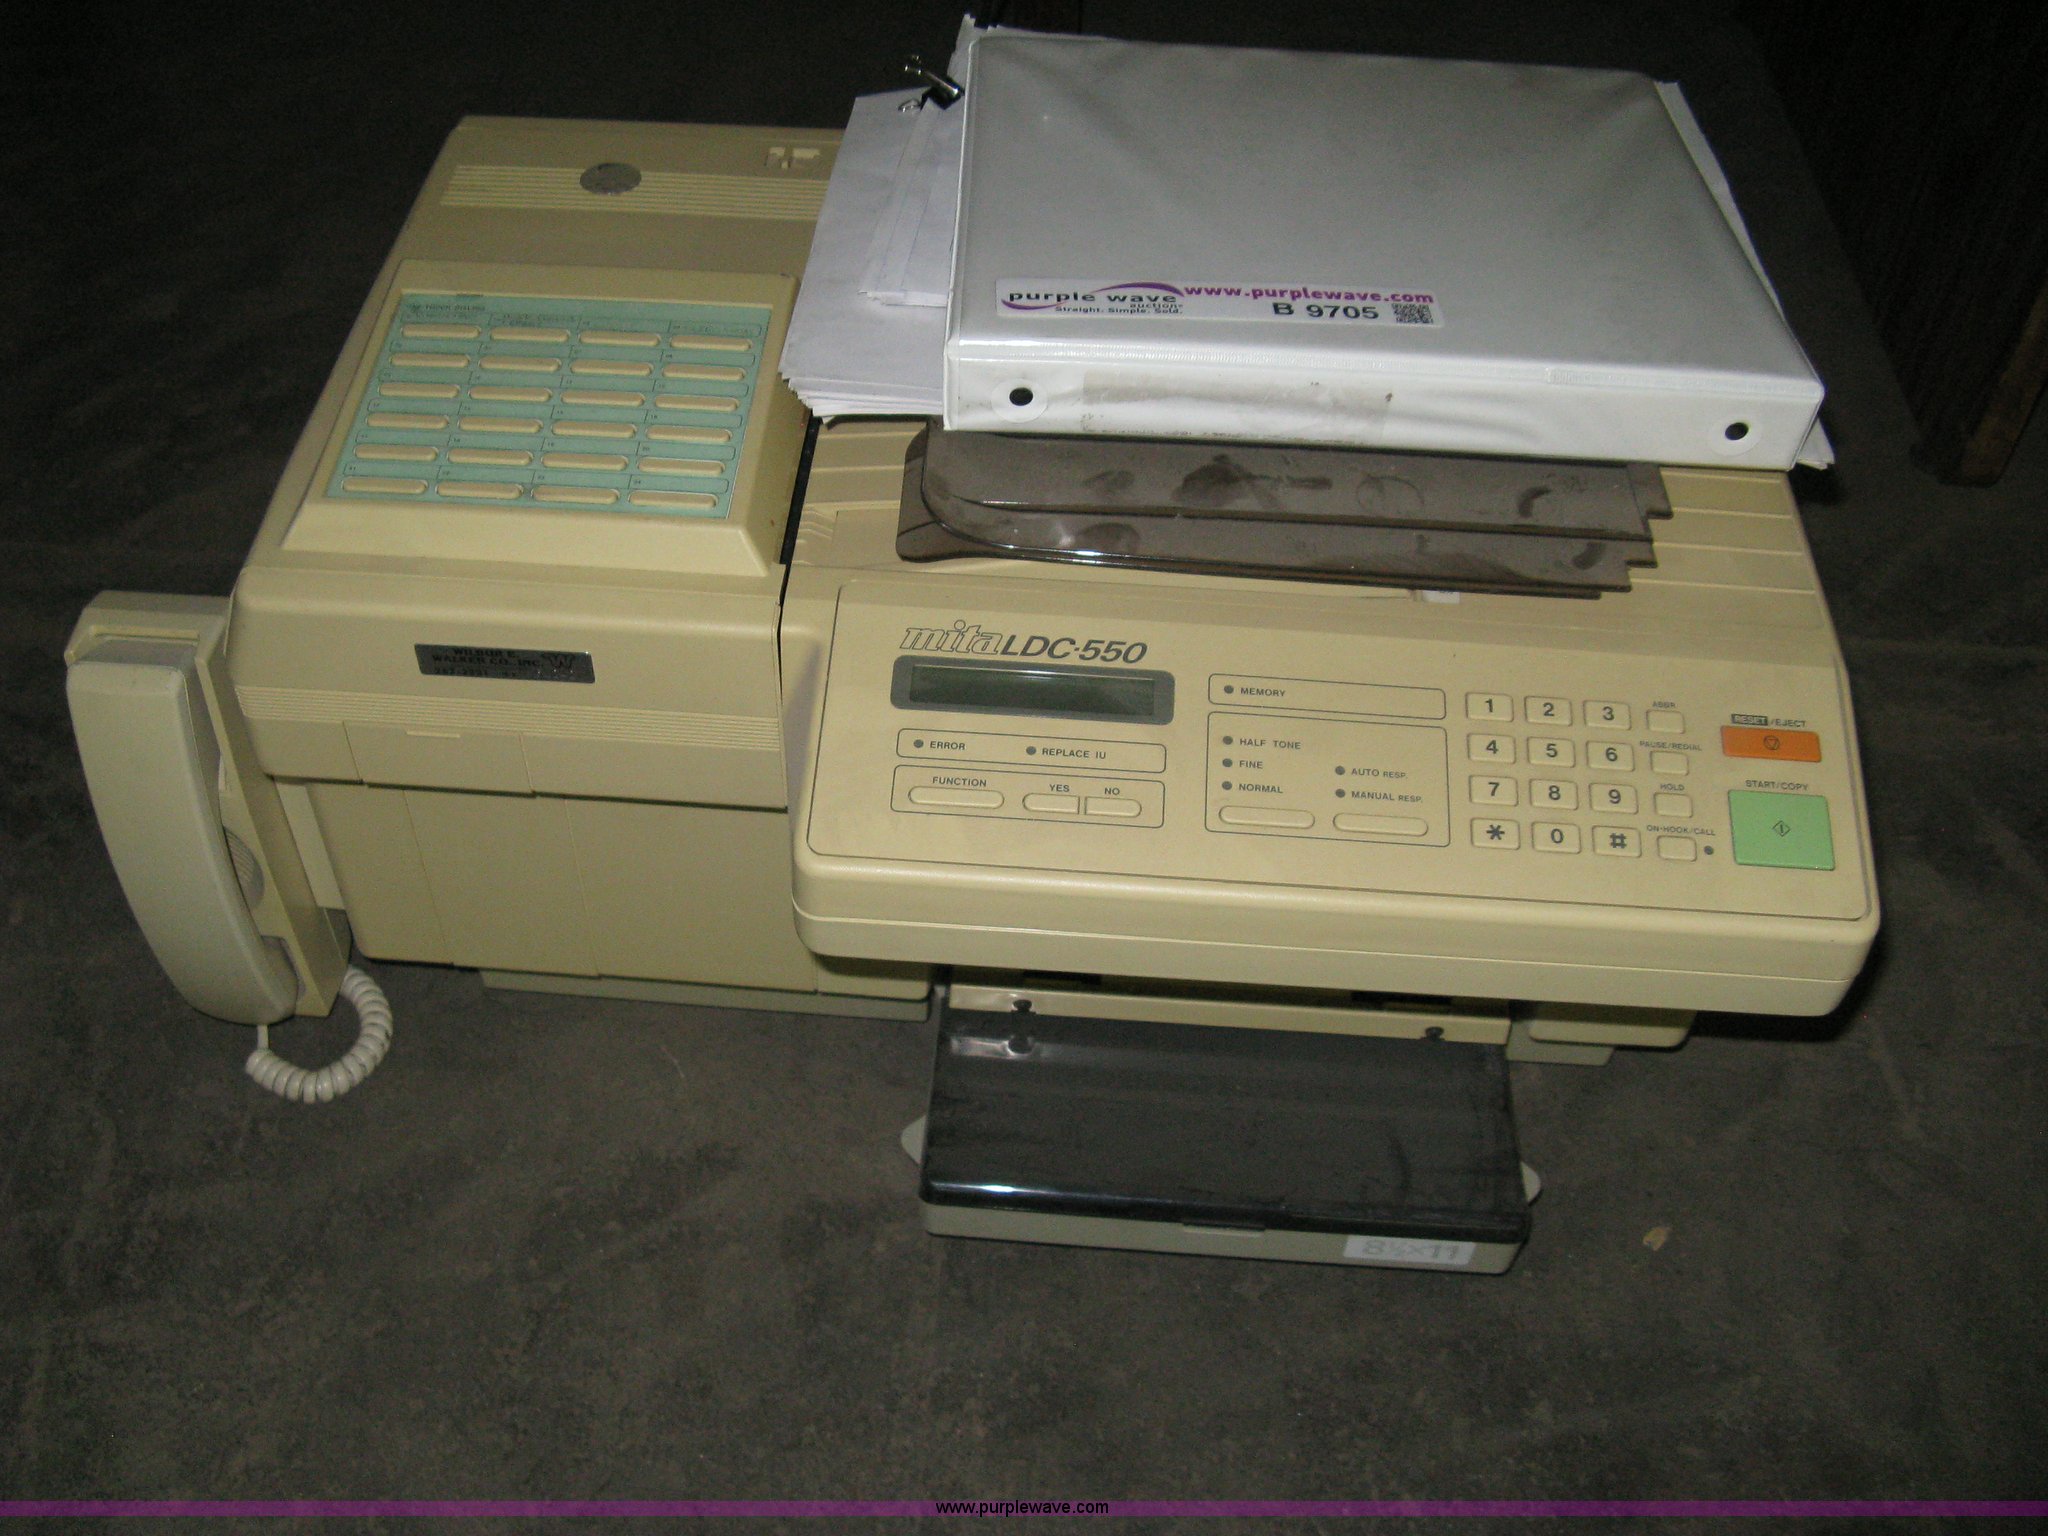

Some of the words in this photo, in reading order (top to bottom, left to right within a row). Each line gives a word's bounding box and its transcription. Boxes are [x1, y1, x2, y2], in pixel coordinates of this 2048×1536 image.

[1008, 291, 1096, 303] purple
[1106, 294, 1178, 303] wave
[1183, 286, 1434, 304] www.purplewave.com
[1272, 302, 1295, 316] B
[1305, 304, 1380, 319] 9705
[899, 619, 1004, 655] mita
[1239, 686, 1287, 698] MEMORY
[1485, 698, 1494, 713] 1
[1542, 702, 1555, 717] 2
[1602, 706, 1615, 721] 3
[929, 740, 967, 751] ERROR
[1041, 747, 1091, 759] REPLACE
[1239, 737, 1267, 748] HALF
[1273, 740, 1302, 751] TONE
[1486, 740, 1499, 755] 4
[1546, 743, 1559, 758] 5
[1605, 747, 1619, 762] 6
[1239, 759, 1264, 770] FINE
[1350, 767, 1380, 778] AUTO
[932, 776, 988, 788] FUNCTION
[1049, 783, 1071, 794] YES
[1104, 786, 1121, 796] NO
[1238, 782, 1284, 795] NORMAL
[1488, 781, 1500, 797] 7
[1548, 785, 1562, 800] 8
[1608, 789, 1622, 804] 9
[1660, 783, 1685, 792] HOLD
[1745, 779, 1809, 792] START/COPY
[1351, 789, 1396, 802] MANUAL
[1551, 828, 1565, 844] 0
